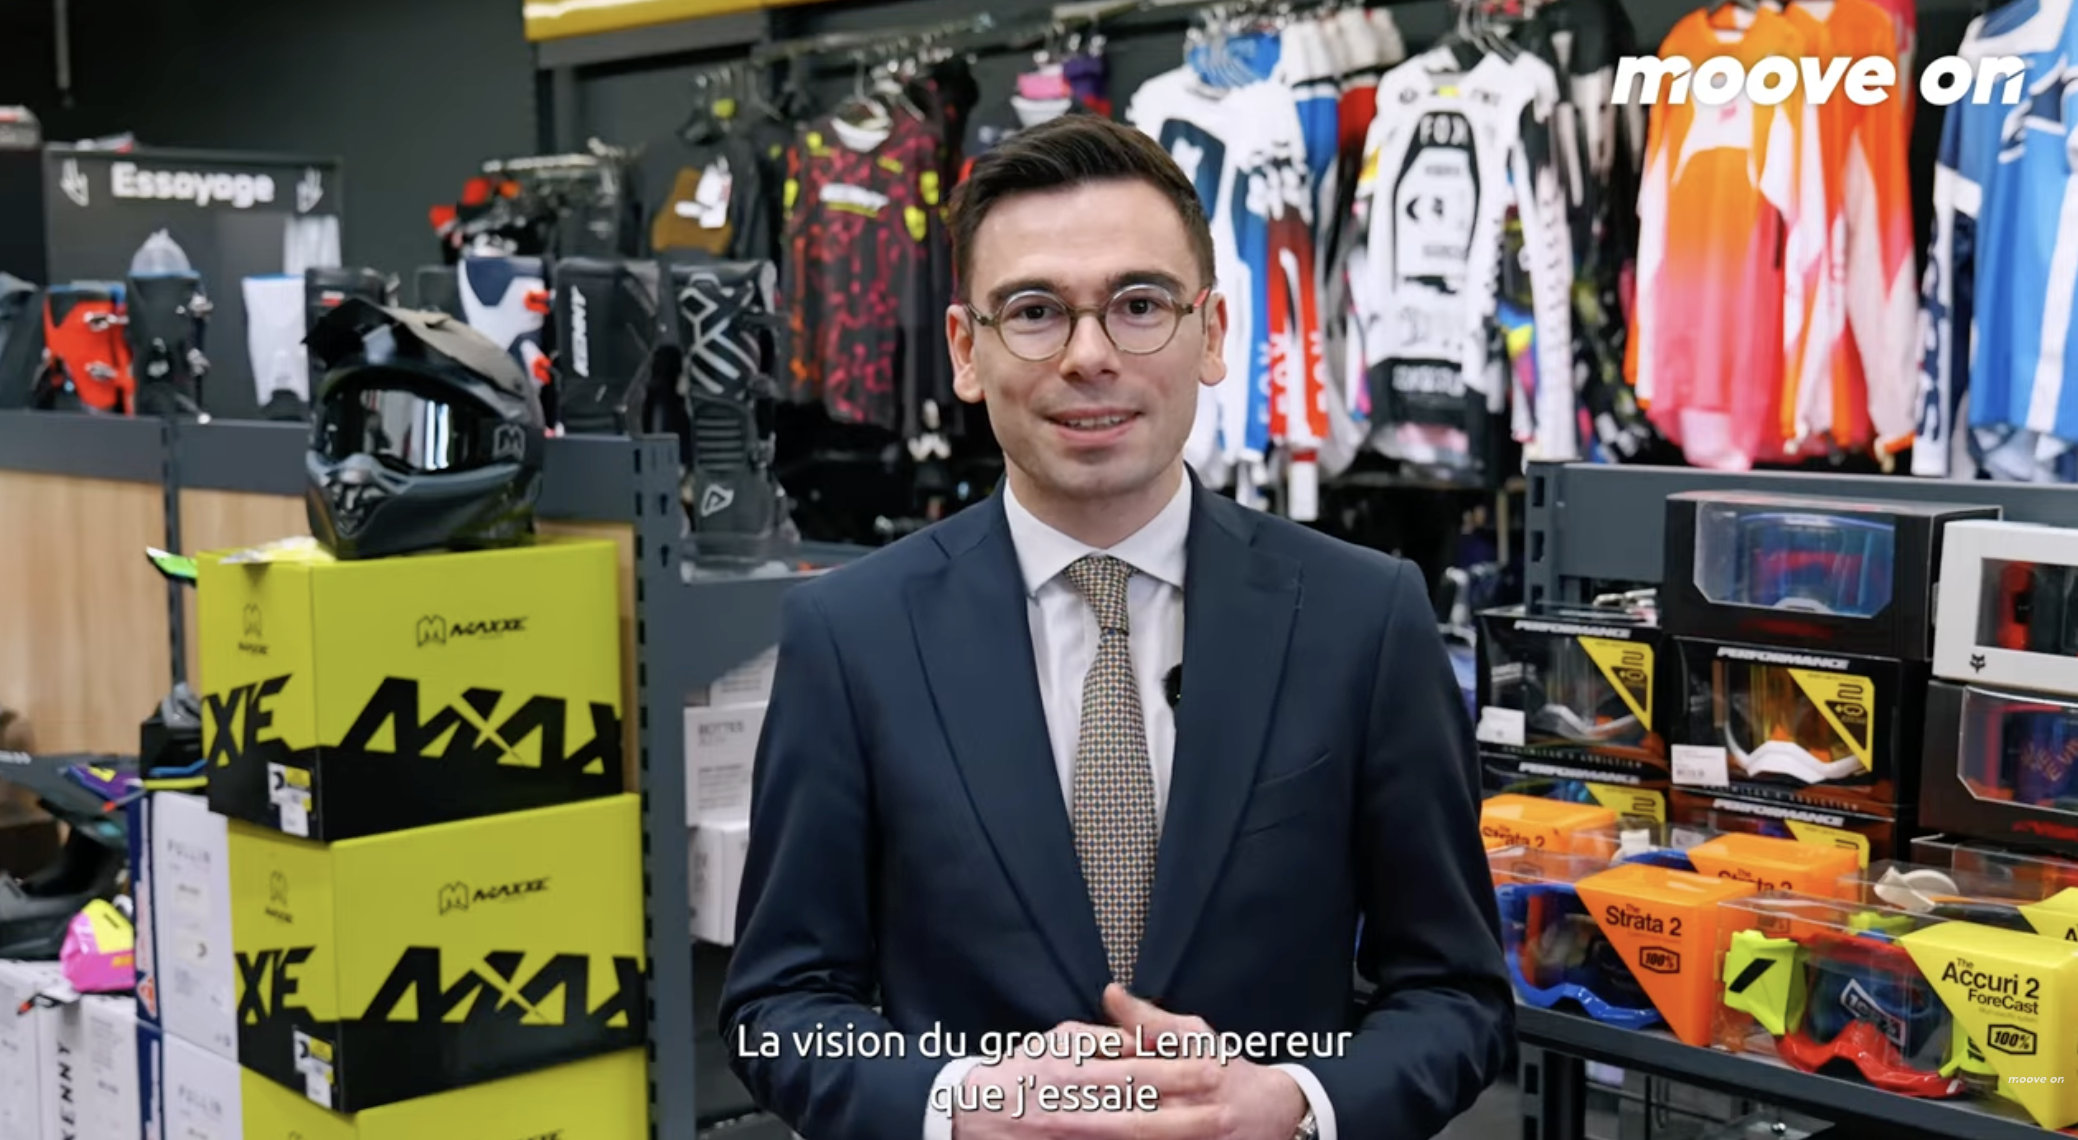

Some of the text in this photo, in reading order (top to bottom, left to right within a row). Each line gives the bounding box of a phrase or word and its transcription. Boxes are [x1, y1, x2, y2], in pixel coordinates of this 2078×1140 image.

[111, 161, 275, 208] Essayage
[1514, 620, 1631, 638] PERFORMANCE
[1717, 646, 1849, 670] PERFORMANCE
[1519, 762, 1640, 784] PERFORMANCE
[1713, 799, 1844, 826] PERFORMANCE
[1626, 904, 1640, 913] The
[1605, 905, 1682, 936] Strata 2
[1645, 952, 1675, 969] 100%
[1956, 957, 1974, 969] The
[1941, 961, 2040, 999] Accuri 2
[1968, 988, 2039, 1015] ForeCast
[1994, 1030, 2030, 1049] 100%
